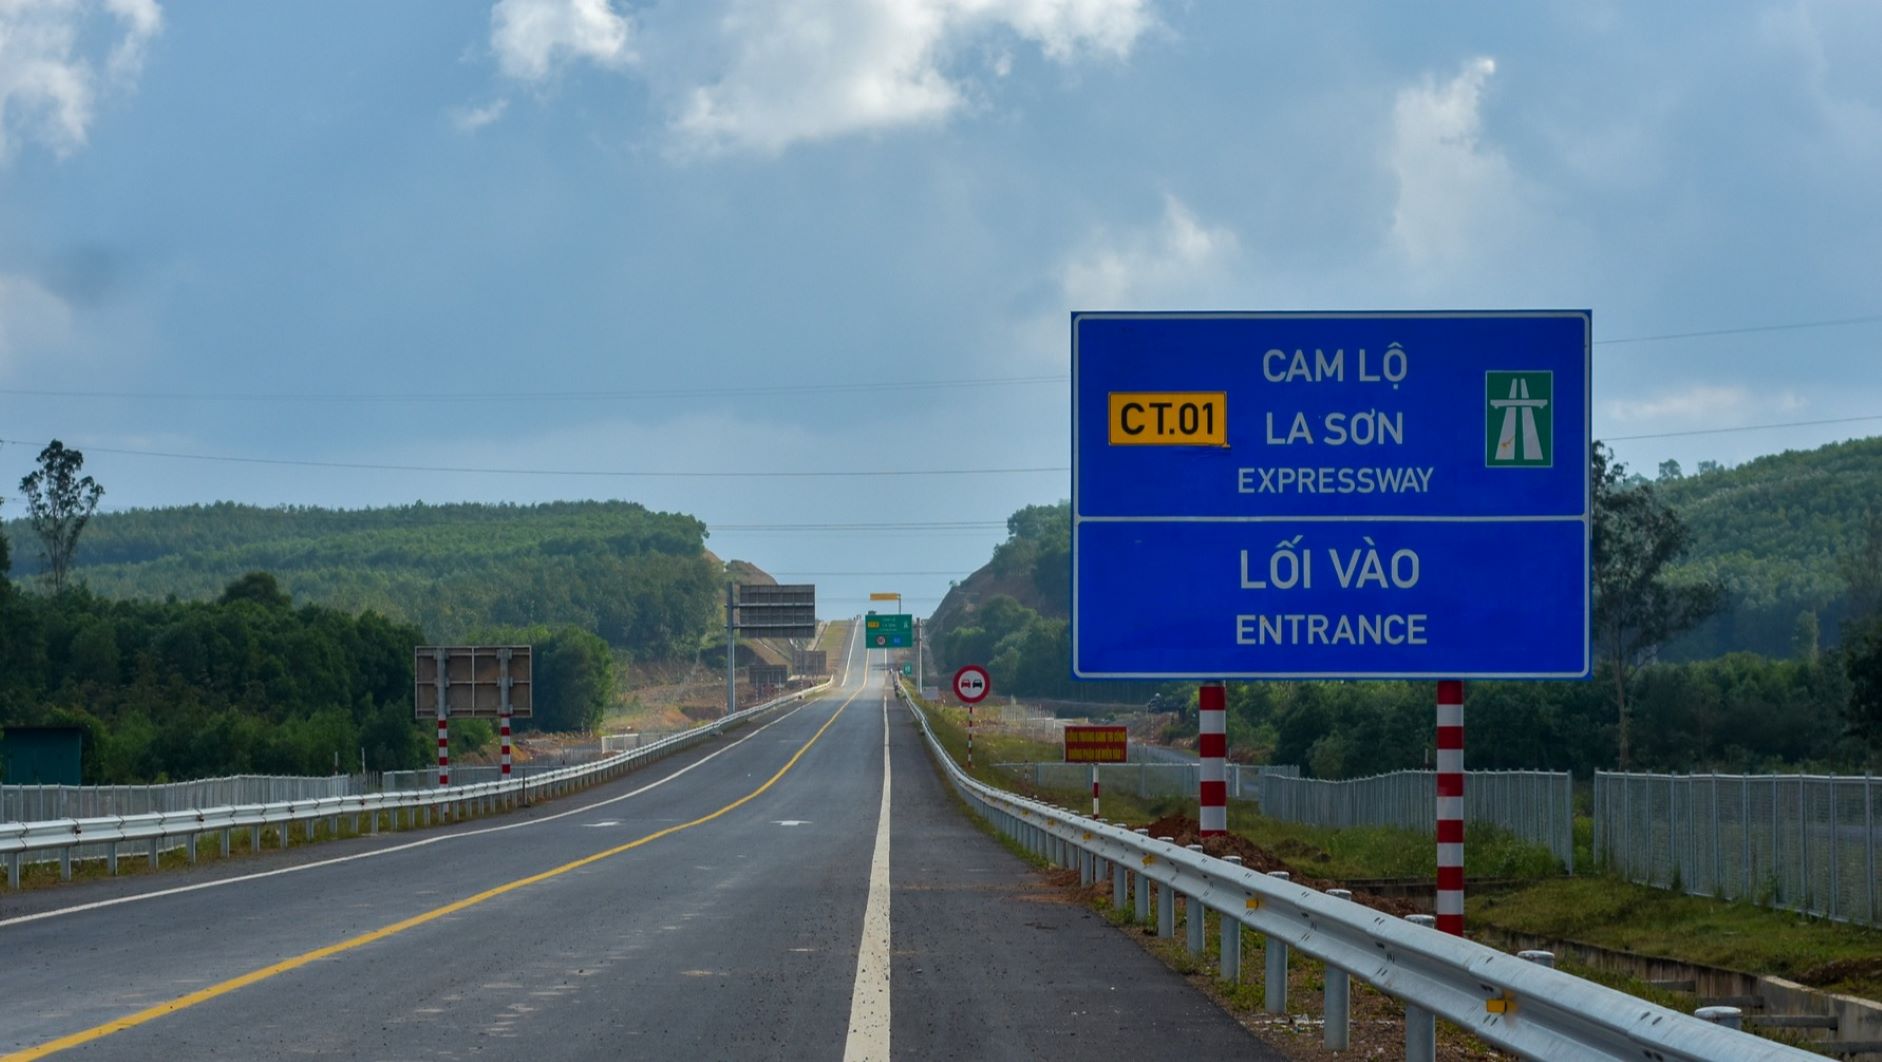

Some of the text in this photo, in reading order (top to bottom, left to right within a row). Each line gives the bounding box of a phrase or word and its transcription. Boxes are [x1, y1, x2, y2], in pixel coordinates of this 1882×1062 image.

[1263, 341, 1409, 390] CAM LỘ
[1120, 401, 1215, 436] CT.01
[1266, 407, 1404, 445] LA SƠN
[1238, 467, 1434, 493] EXPRESSWAY
[1240, 535, 1420, 589] LỐI VÀO
[1236, 614, 1427, 645] ENTRANCE
